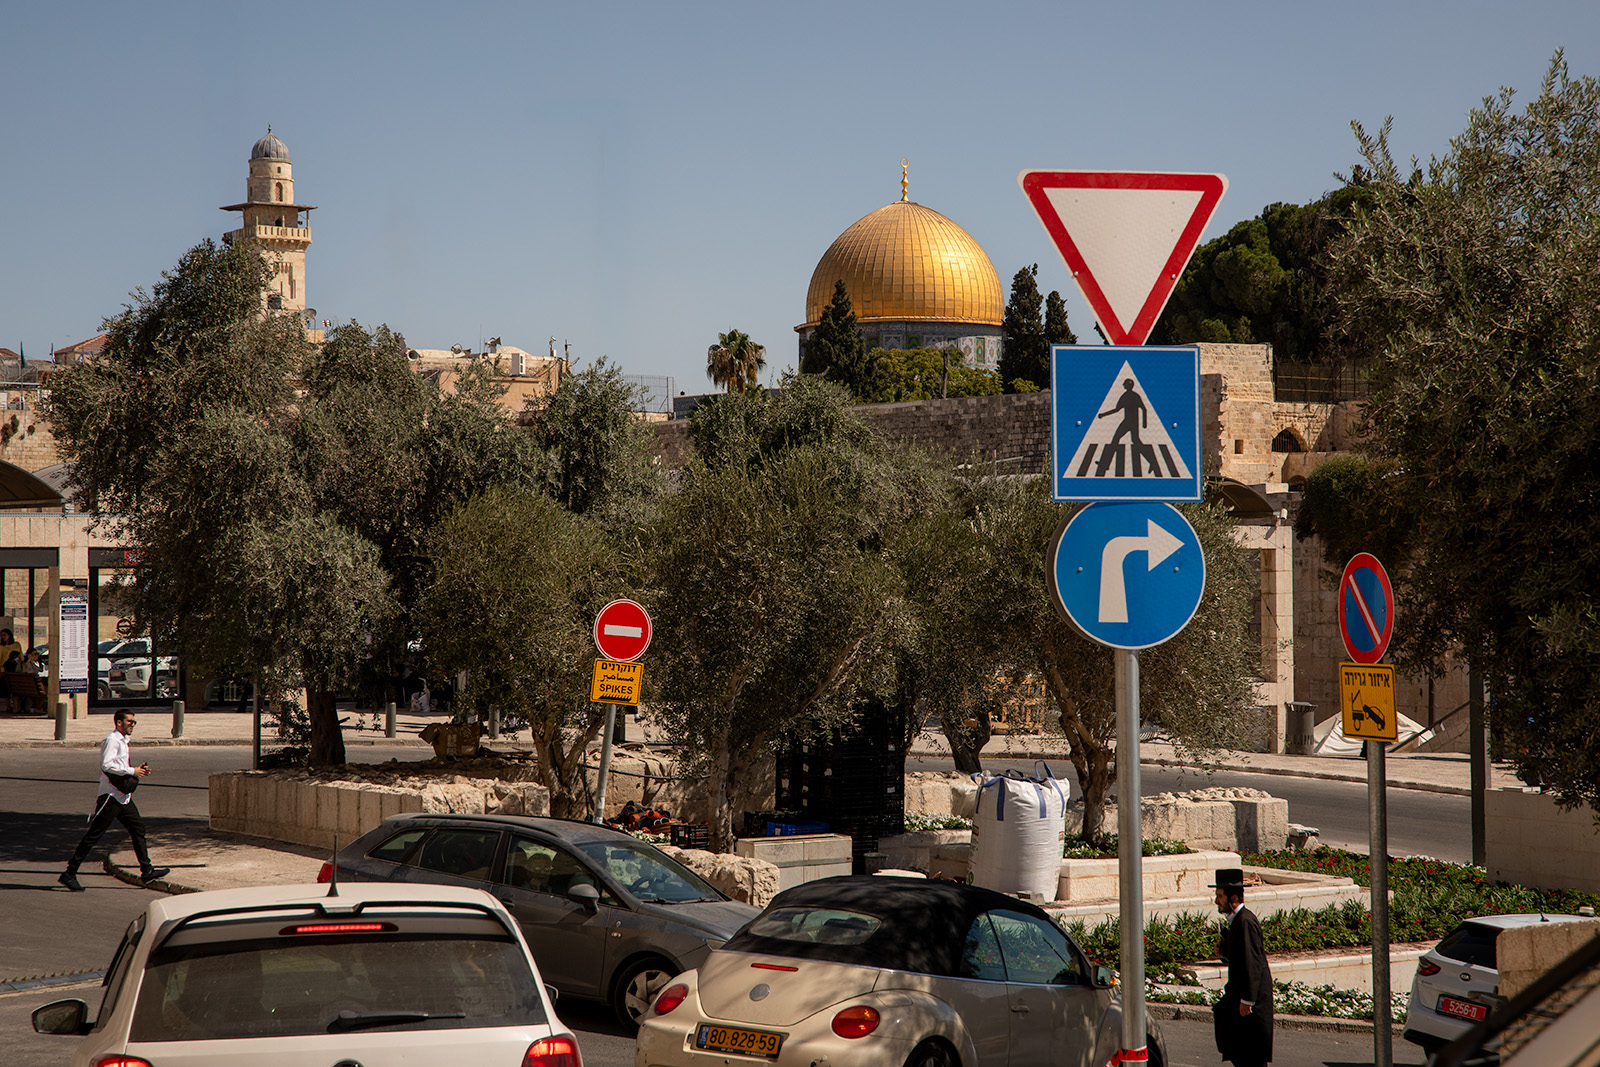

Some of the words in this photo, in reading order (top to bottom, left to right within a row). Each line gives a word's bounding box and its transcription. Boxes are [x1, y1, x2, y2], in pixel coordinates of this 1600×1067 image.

[601, 662, 637, 673] דוקרנים
[600, 672, 634, 682] مسامير
[1344, 671, 1366, 686] גרירה
[1368, 672, 1390, 687] איזור
[599, 683, 633, 694] SPIKES
